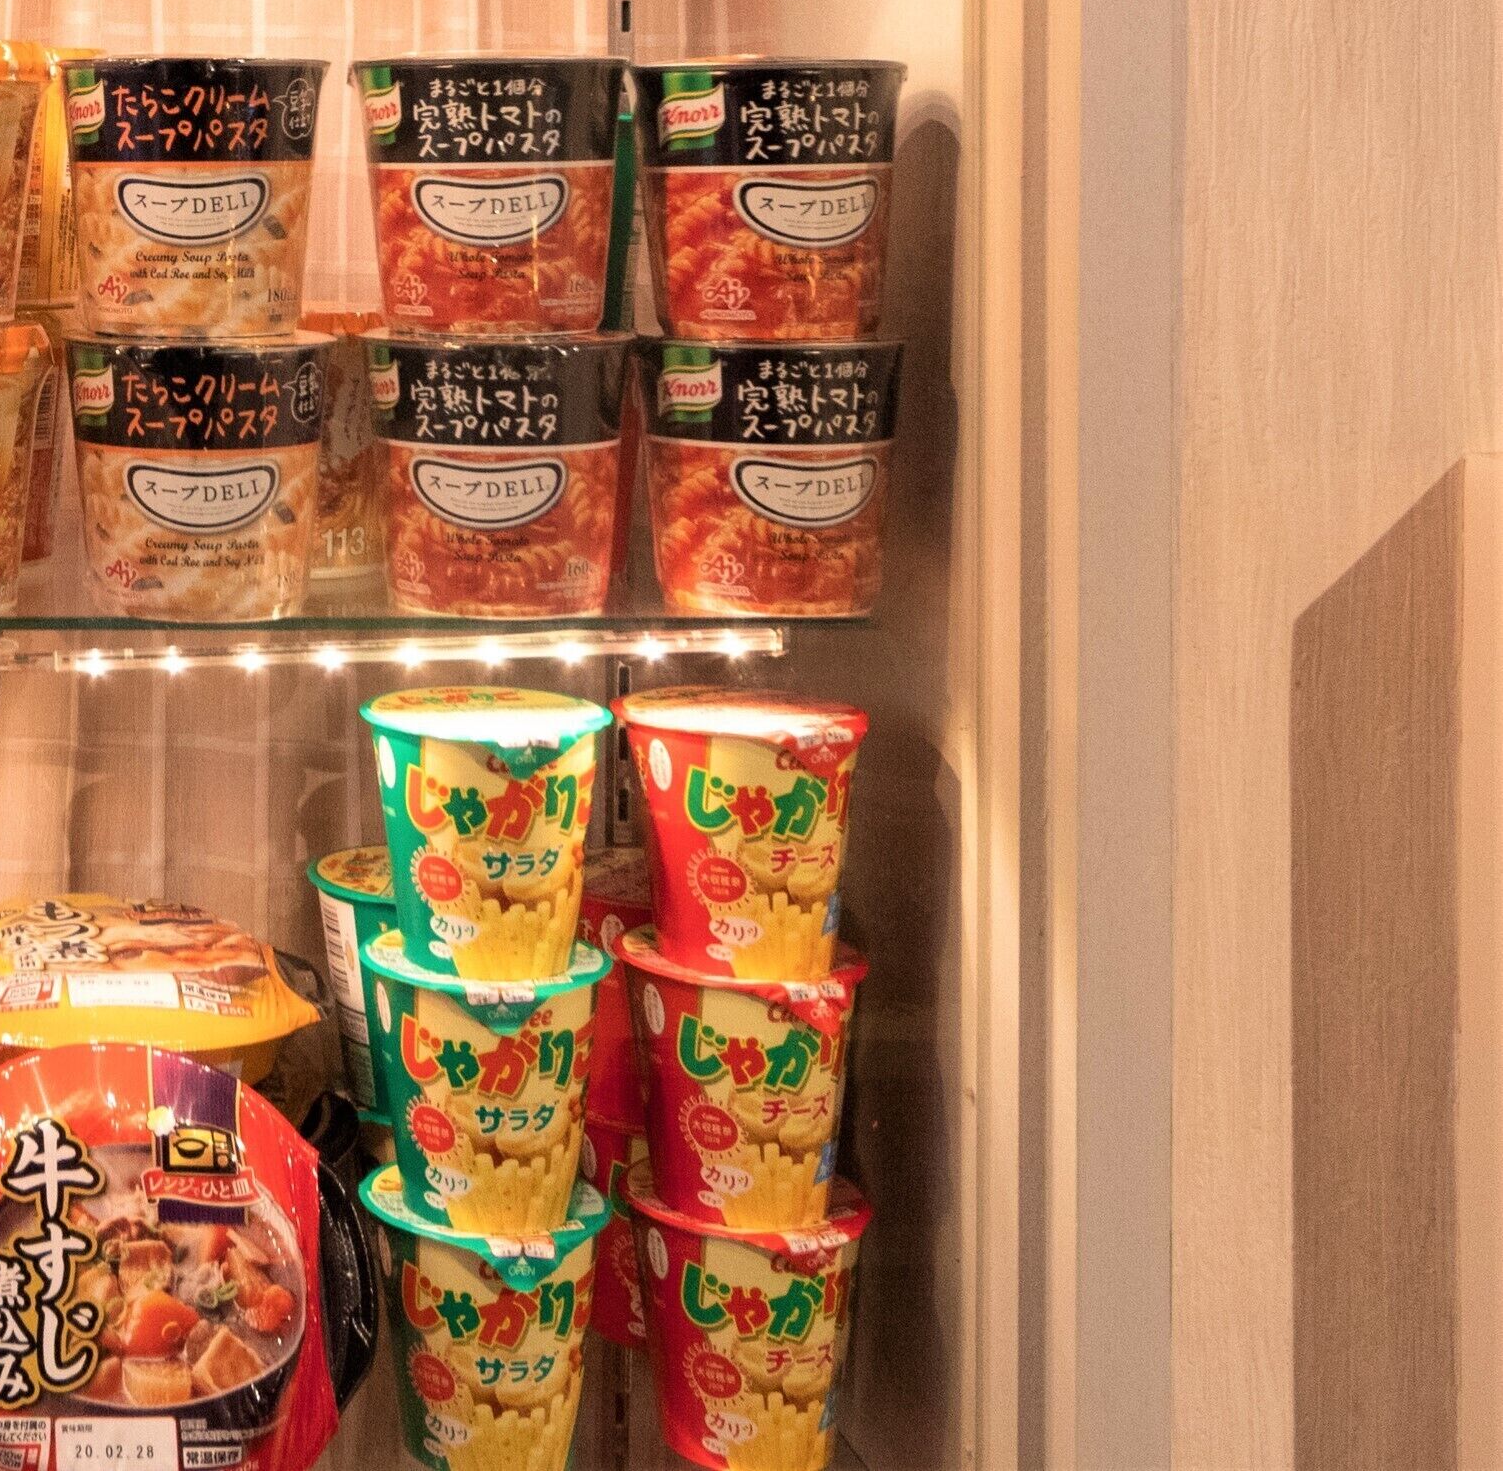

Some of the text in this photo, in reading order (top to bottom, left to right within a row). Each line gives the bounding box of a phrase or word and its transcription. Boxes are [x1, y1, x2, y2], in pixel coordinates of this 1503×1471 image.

[111, 84, 271, 120] たらこクリーム
[412, 99, 562, 133] 完熟トマトの
[662, 103, 721, 127] Knorr
[740, 101, 881, 136] 完熟トマトの
[115, 118, 269, 153] スープパスタ
[417, 130, 561, 158] スープパスタ
[745, 132, 881, 160] スープパスタ
[134, 190, 255, 215] スープDELI
[432, 190, 552, 215] スープDELI
[135, 249, 212, 266] Creamy Soup
[120, 373, 281, 406] たらこクリーム
[410, 381, 558, 415] 完熟トマトの
[664, 377, 718, 398] Knorr
[737, 379, 879, 415] 完熟トマトの
[124, 406, 279, 440] スープパスタ
[414, 414, 557, 441] スープパスタ
[741, 411, 878, 439] スープパスタ
[143, 479, 262, 504] スープDELI
[429, 473, 548, 499] スープDELI
[144, 537, 222, 552] Creamy Soup
[482, 845, 563, 880] サラダ
[770, 842, 836, 874] チーズ
[474, 1100, 559, 1135] サラダ
[762, 1090, 833, 1125] チーズ
[5, 1120, 98, 1382] 牛すじ
[507, 1264, 536, 1277] OPEN
[474, 1350, 559, 1386] サラダ
[765, 1342, 833, 1374] チーズ
[75, 1444, 155, 1460] 20.02.28
[186, 1448, 241, 1465] 常温保存
